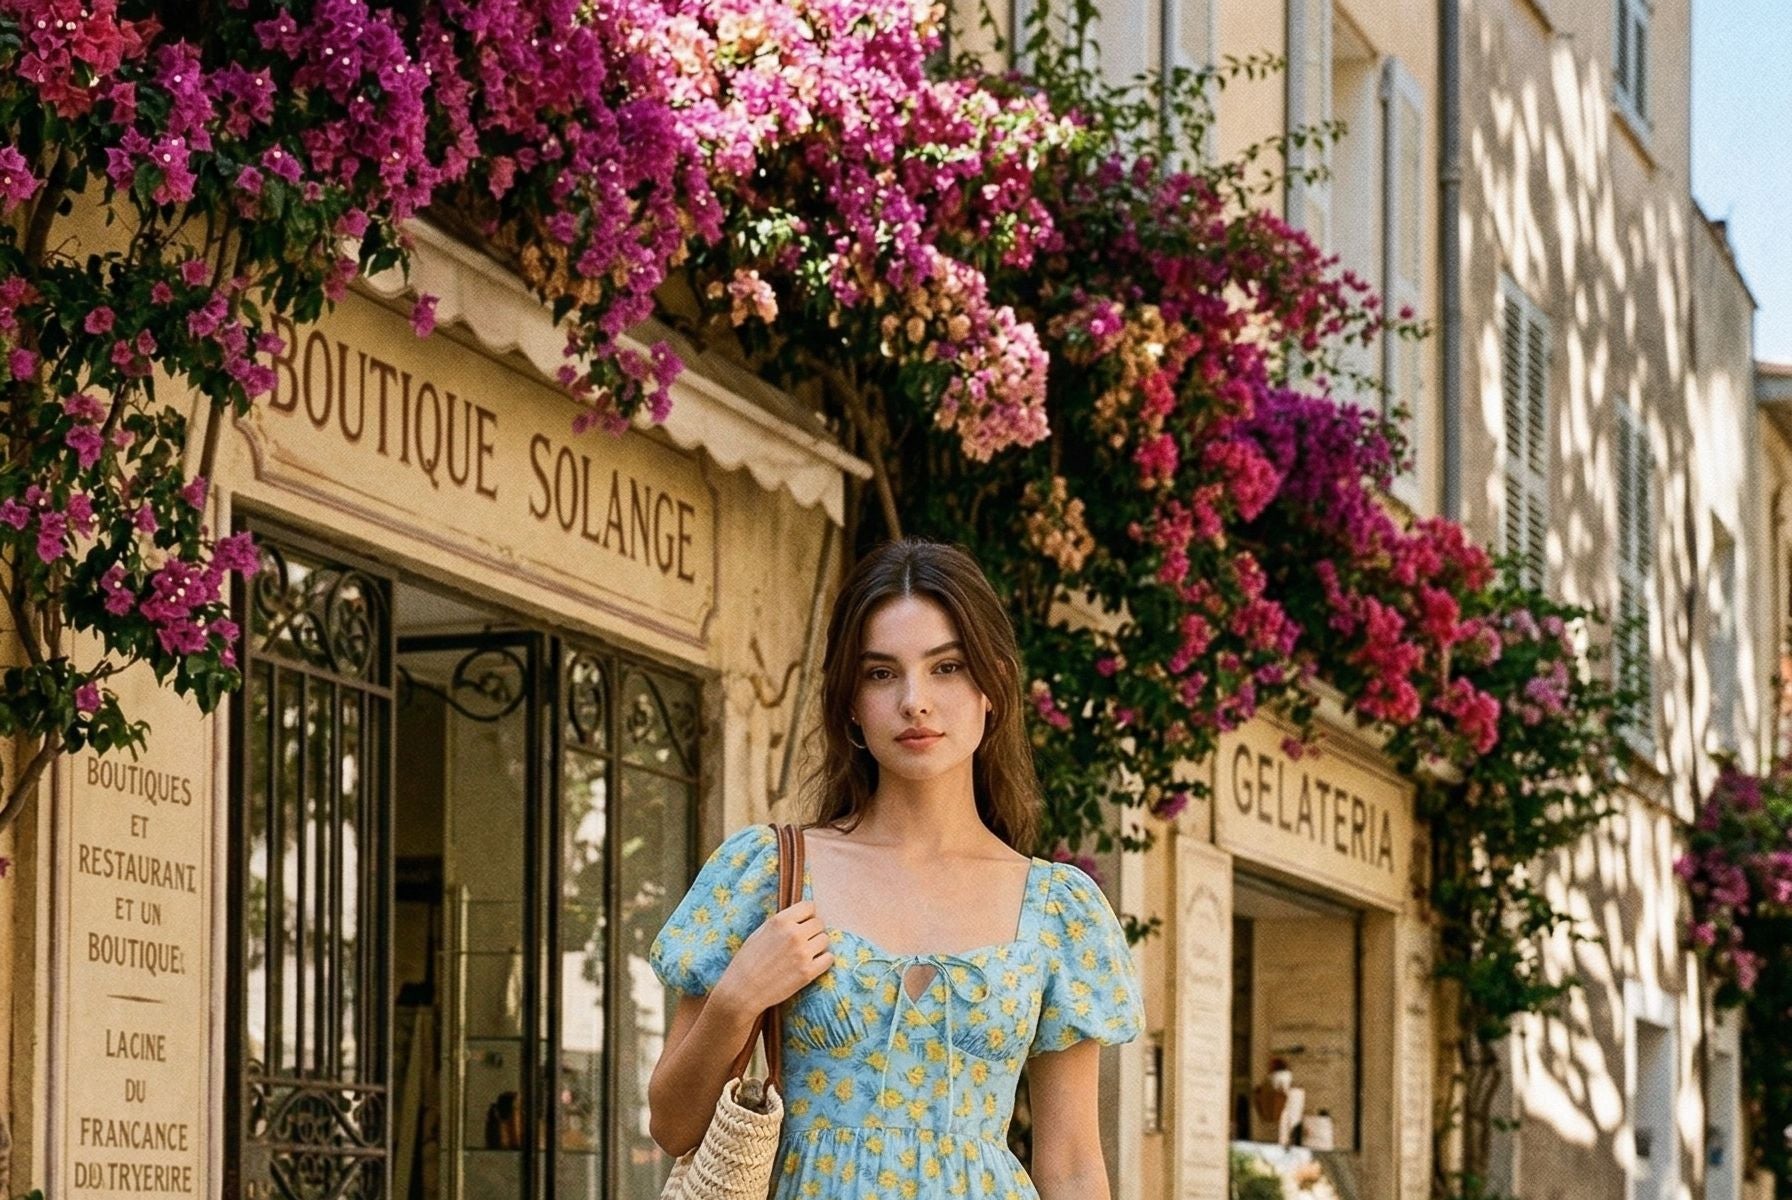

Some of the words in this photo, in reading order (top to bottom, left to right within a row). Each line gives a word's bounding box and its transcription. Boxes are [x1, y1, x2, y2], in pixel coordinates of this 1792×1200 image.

[269, 313, 499, 501] BOUTIQUE
[528, 432, 697, 584] SOLANGE
[87, 756, 192, 807] BOUTIQUES
[1232, 743, 1394, 874] GELATERIA
[130, 814, 149, 839] ET
[115, 897, 134, 922] ET
[141, 901, 162, 926] UN
[105, 1028, 167, 1063] LACINE
[125, 1078, 146, 1104] DU
[80, 1117, 188, 1152] FRANCANCE
